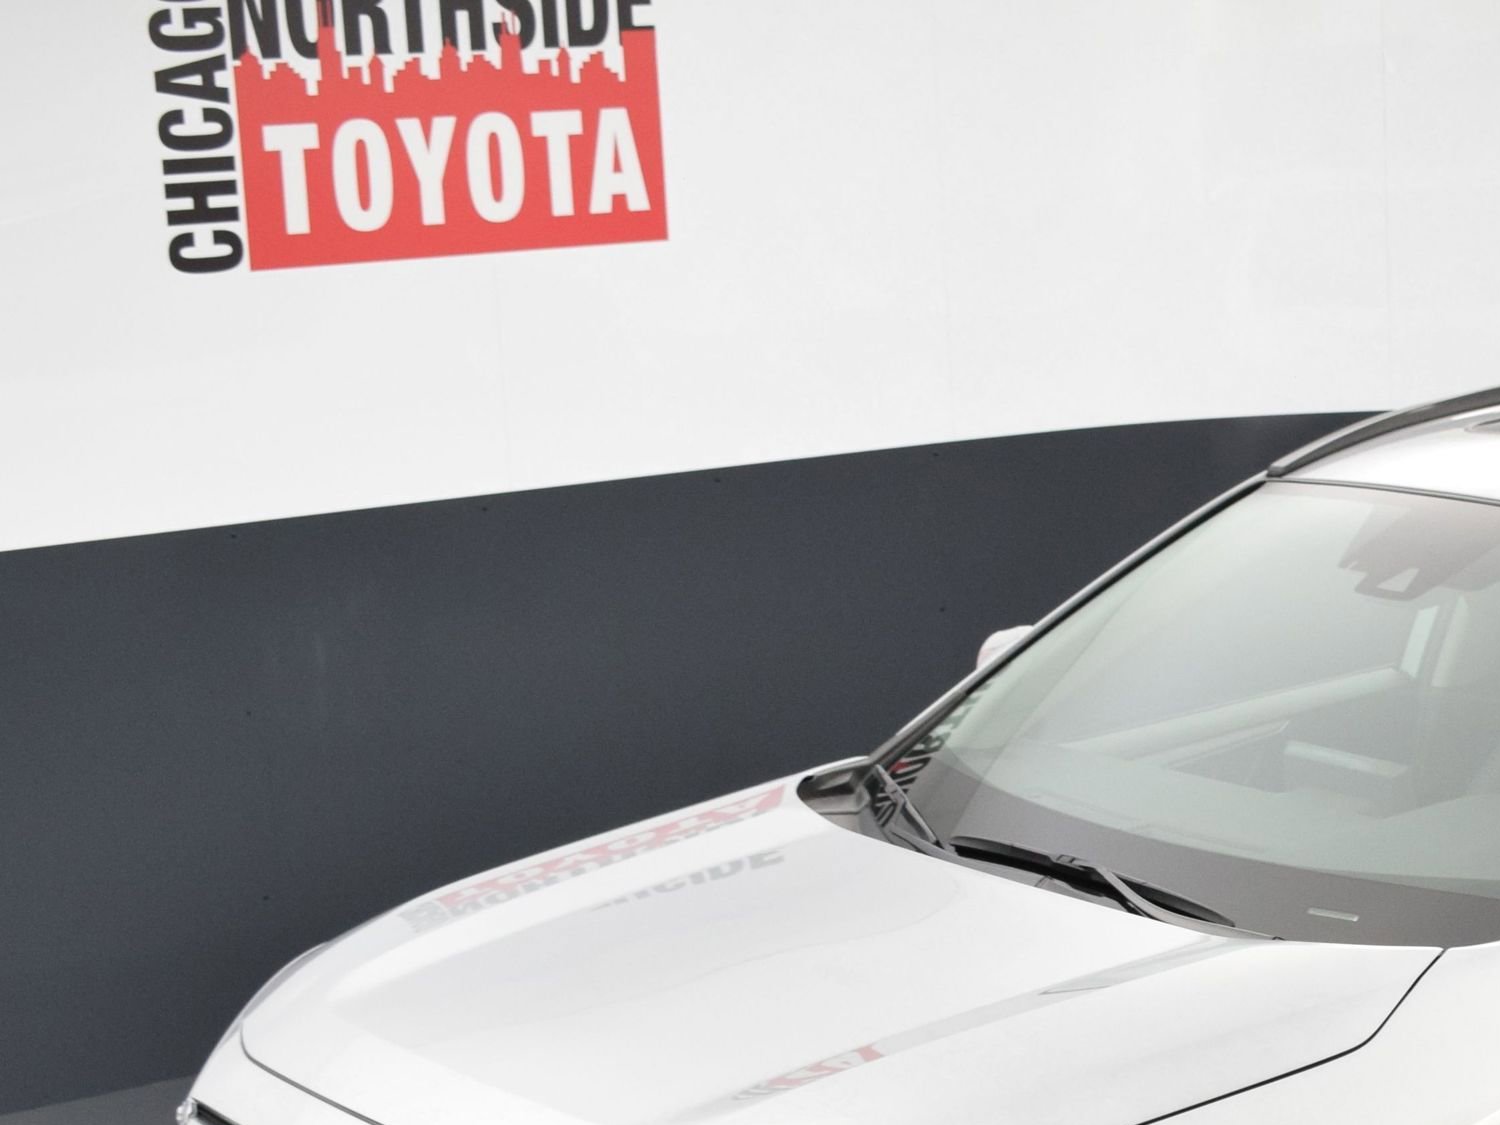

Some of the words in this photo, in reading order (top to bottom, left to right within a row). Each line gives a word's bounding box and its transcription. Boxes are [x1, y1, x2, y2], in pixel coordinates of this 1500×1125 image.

[227, 0, 655, 60] NORTHS
[148, 0, 243, 274] CHICAG
[262, 107, 651, 235] TOYOTA
